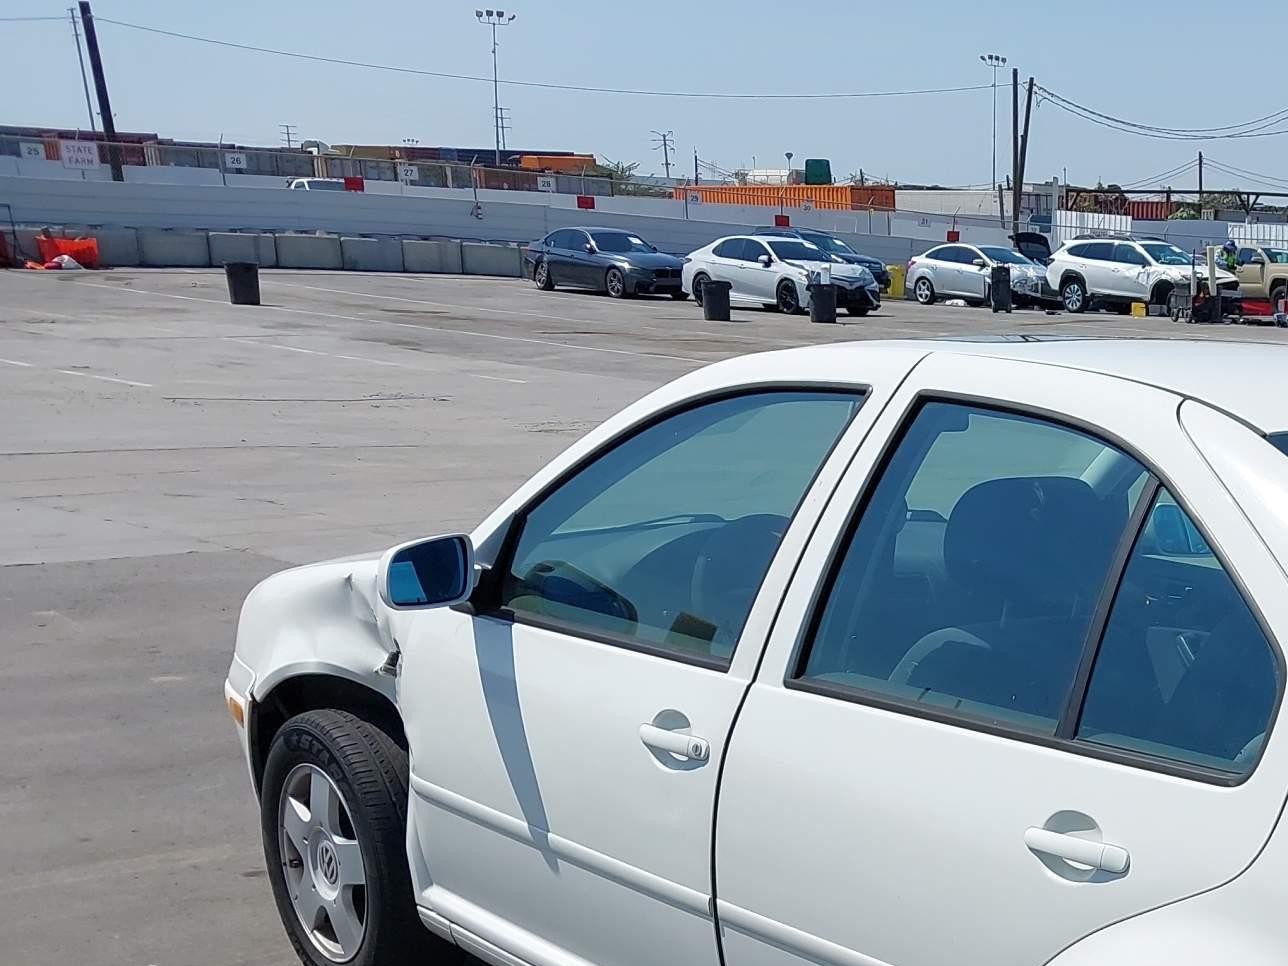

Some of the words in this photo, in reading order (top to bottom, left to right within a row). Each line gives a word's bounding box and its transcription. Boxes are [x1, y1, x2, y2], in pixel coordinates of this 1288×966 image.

[65, 144, 93, 154] STATE
[68, 157, 94, 166] FARM
[230, 156, 242, 165] 26
[403, 168, 413, 177] 27
